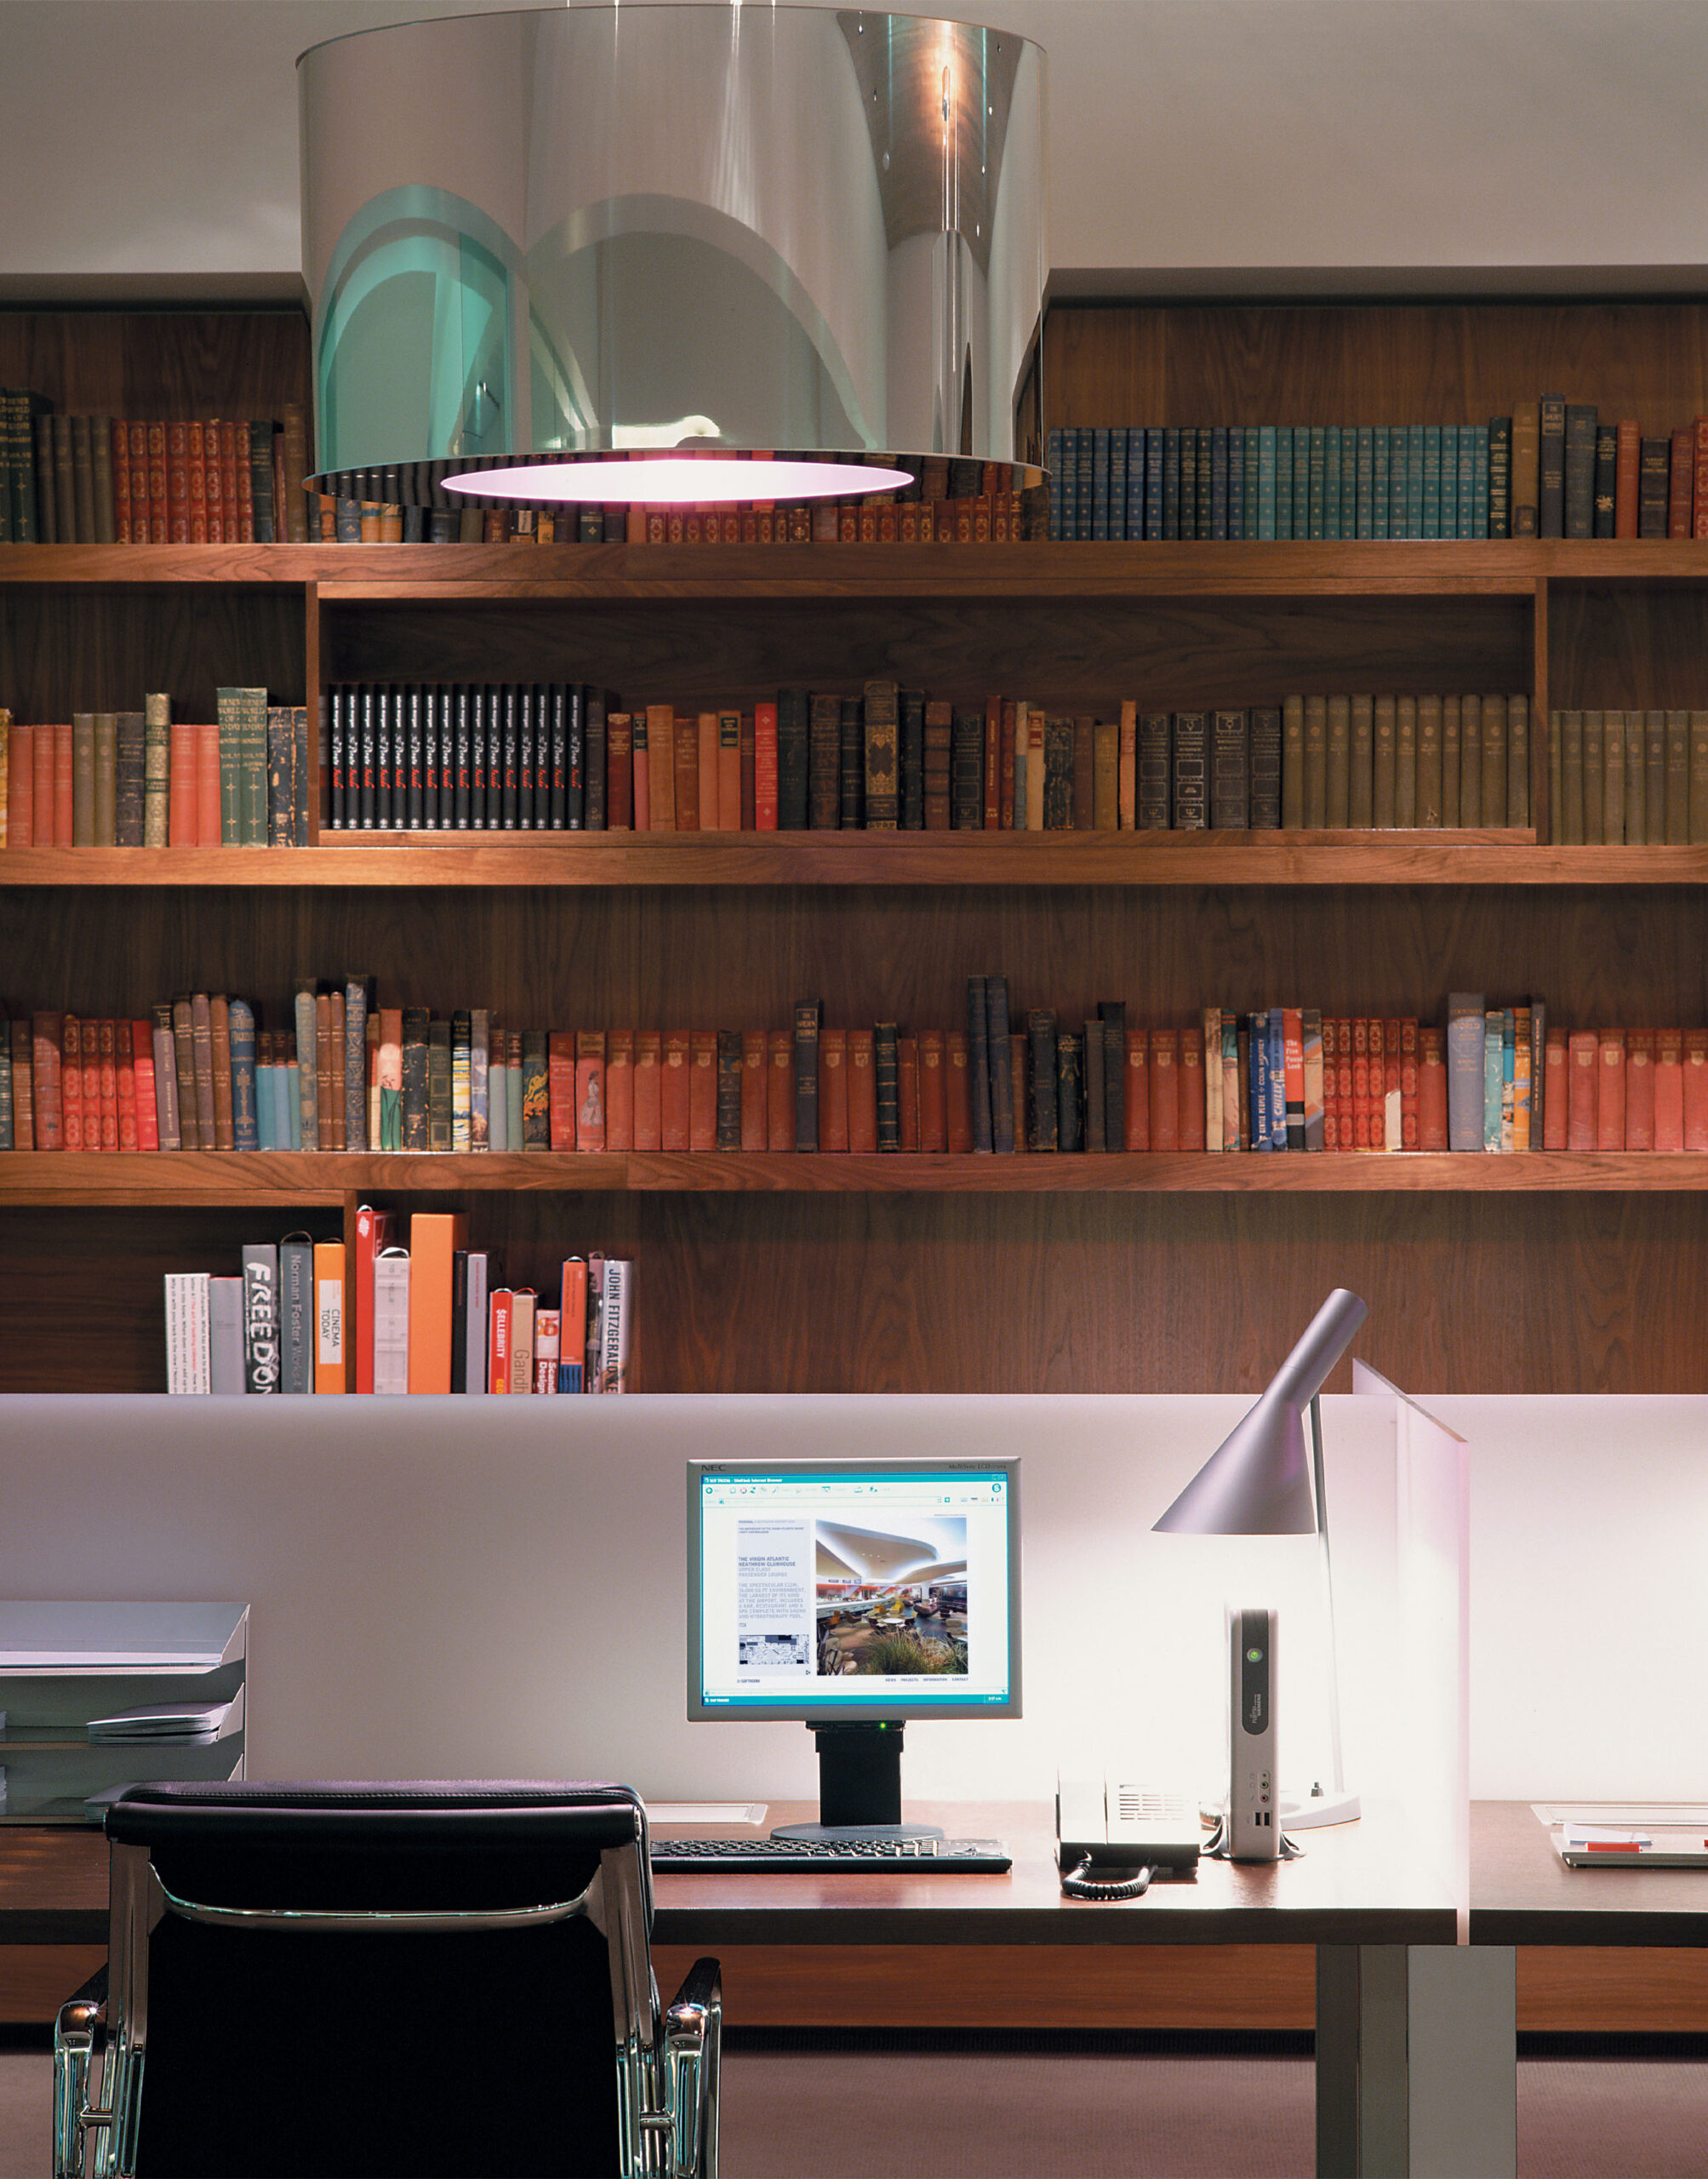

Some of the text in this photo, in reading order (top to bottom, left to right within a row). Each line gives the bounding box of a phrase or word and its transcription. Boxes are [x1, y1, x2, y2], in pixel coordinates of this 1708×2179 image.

[291, 1254, 302, 1301] Norman
[291, 1304, 302, 1341] Foster
[322, 1308, 330, 1339] TODAY
[332, 1308, 340, 1347] CINEMA
[606, 1269, 620, 1393] JOHN FITZGERALD KE
[537, 1361, 547, 1393] Design
